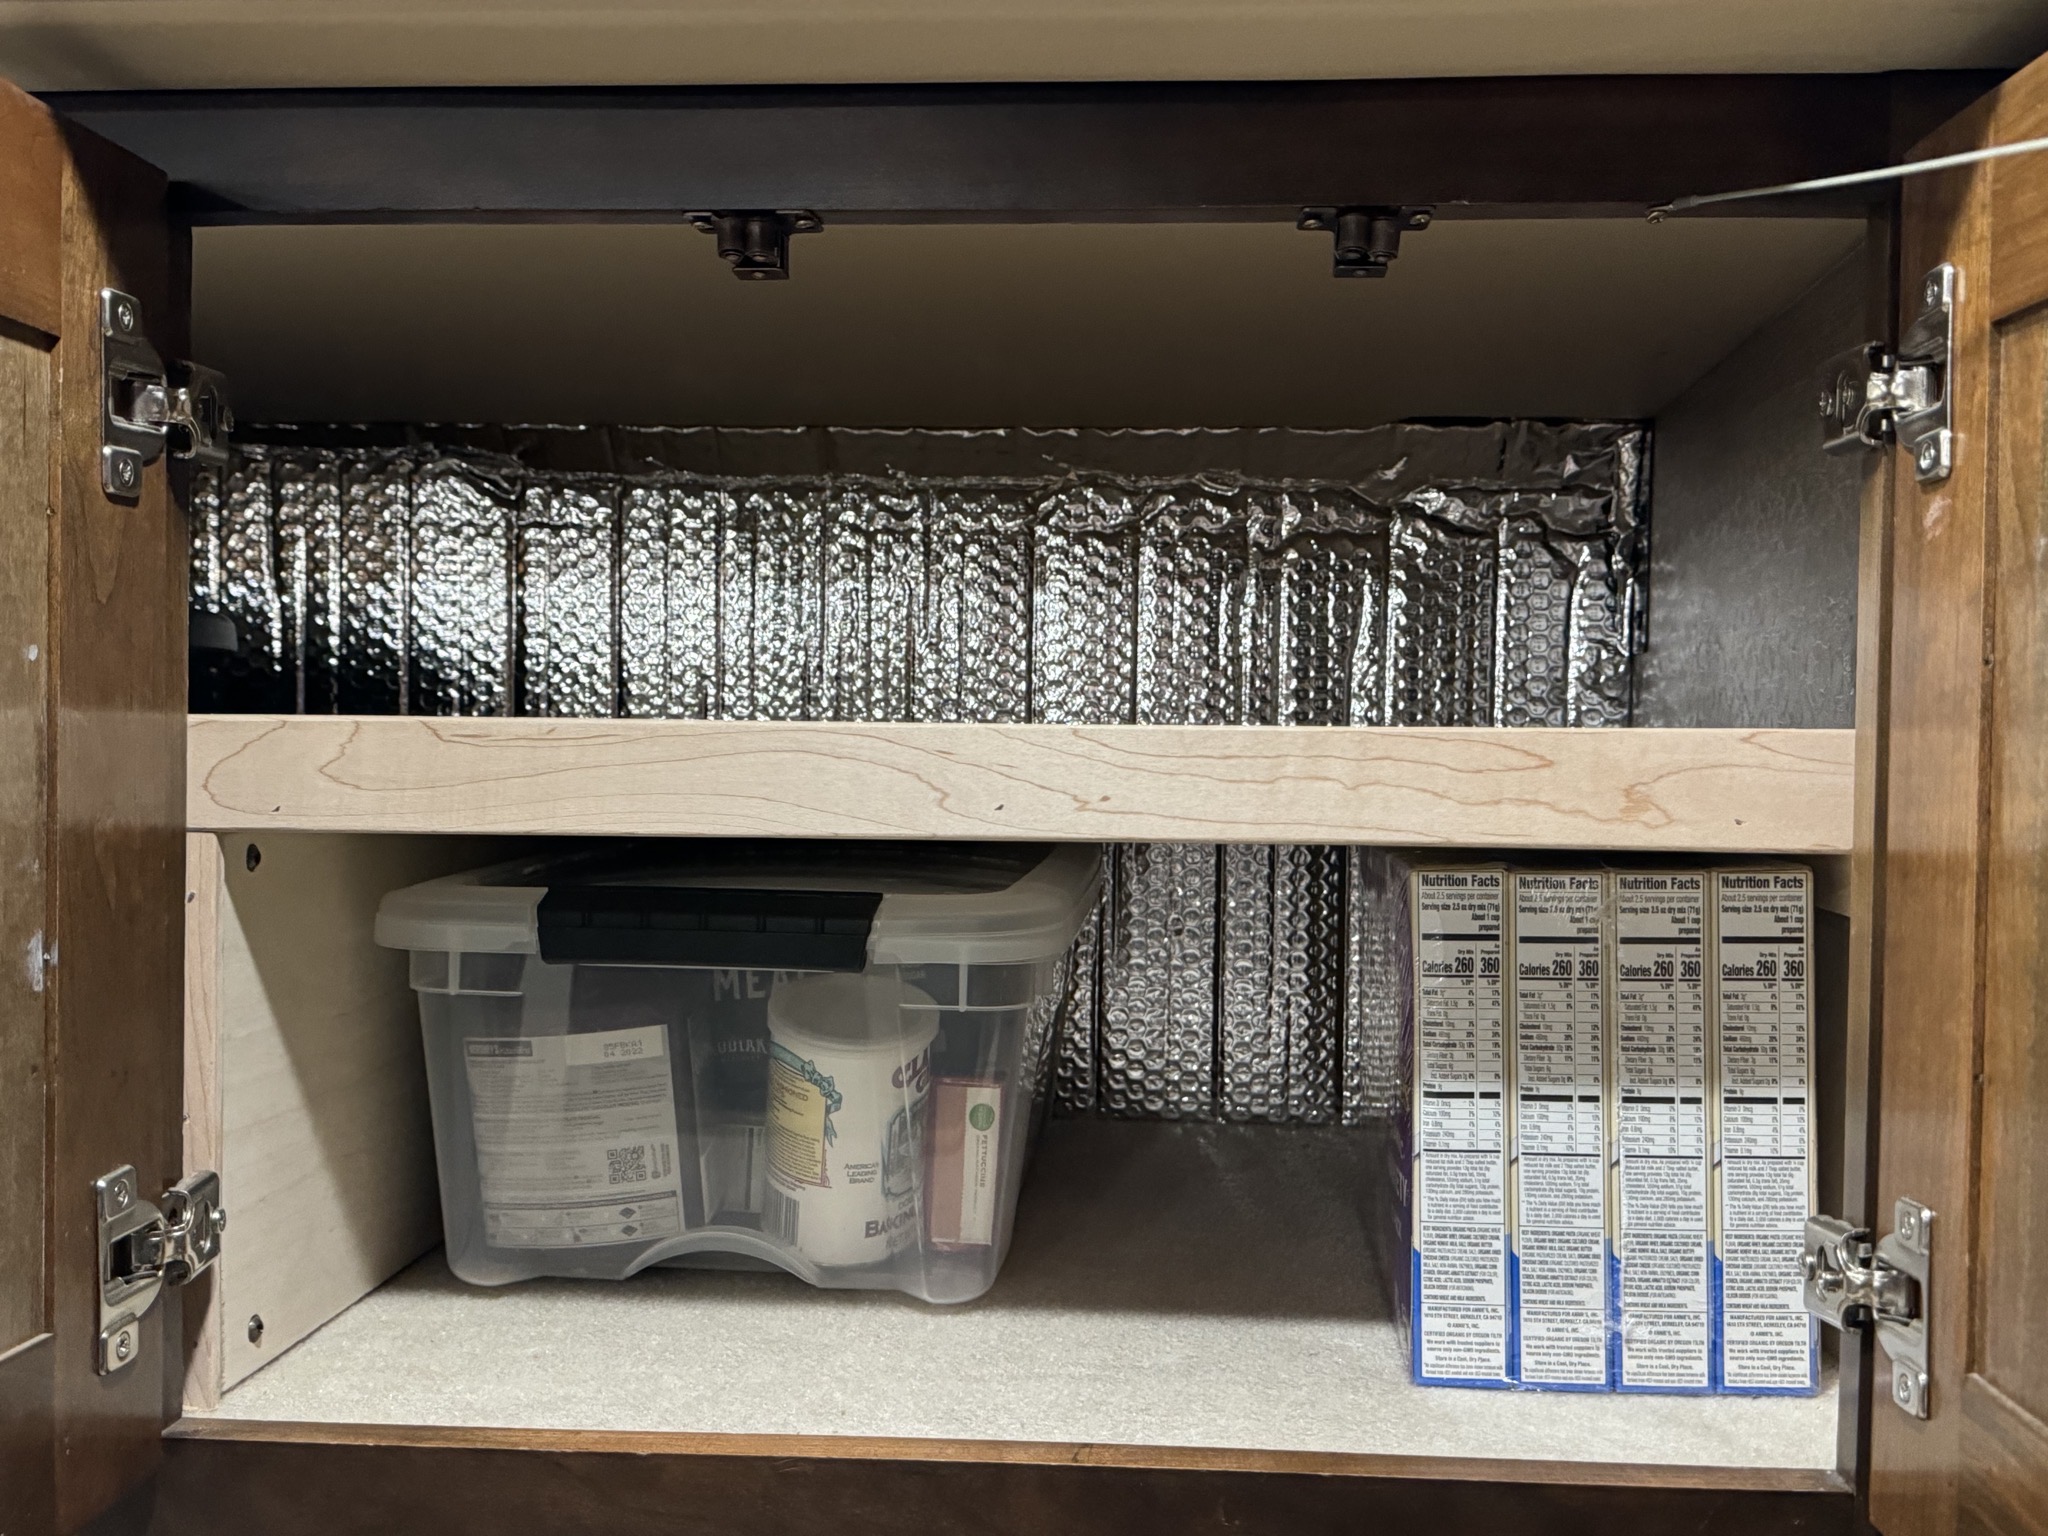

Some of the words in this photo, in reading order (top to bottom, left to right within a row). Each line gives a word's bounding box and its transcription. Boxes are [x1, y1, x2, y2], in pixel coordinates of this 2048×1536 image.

[1422, 874, 1467, 887] Nutrition
[1471, 875, 1499, 887] Facts
[1520, 877, 1566, 889] Nutrition
[1569, 877, 1599, 889] Facts
[1620, 877, 1666, 889] Nutrition
[1671, 877, 1700, 890] Facts
[1722, 876, 1769, 888] Nutrition
[1774, 876, 1803, 888] Facts
[1422, 961, 1452, 973] Calories
[1455, 957, 1473, 973] 260
[1481, 957, 1499, 973] 360
[1520, 963, 1550, 975] Calories
[1552, 960, 1572, 976] 260
[1579, 960, 1599, 976] 360
[1620, 964, 1651, 976] Calories
[1654, 961, 1673, 977] 260
[1681, 961, 1700, 977] 360
[1722, 964, 1754, 976] Calories
[1756, 960, 1776, 976] 260
[1784, 960, 1803, 976] 360
[620, 1047, 644, 1057] 2022
[847, 1169, 877, 1177] LEADING
